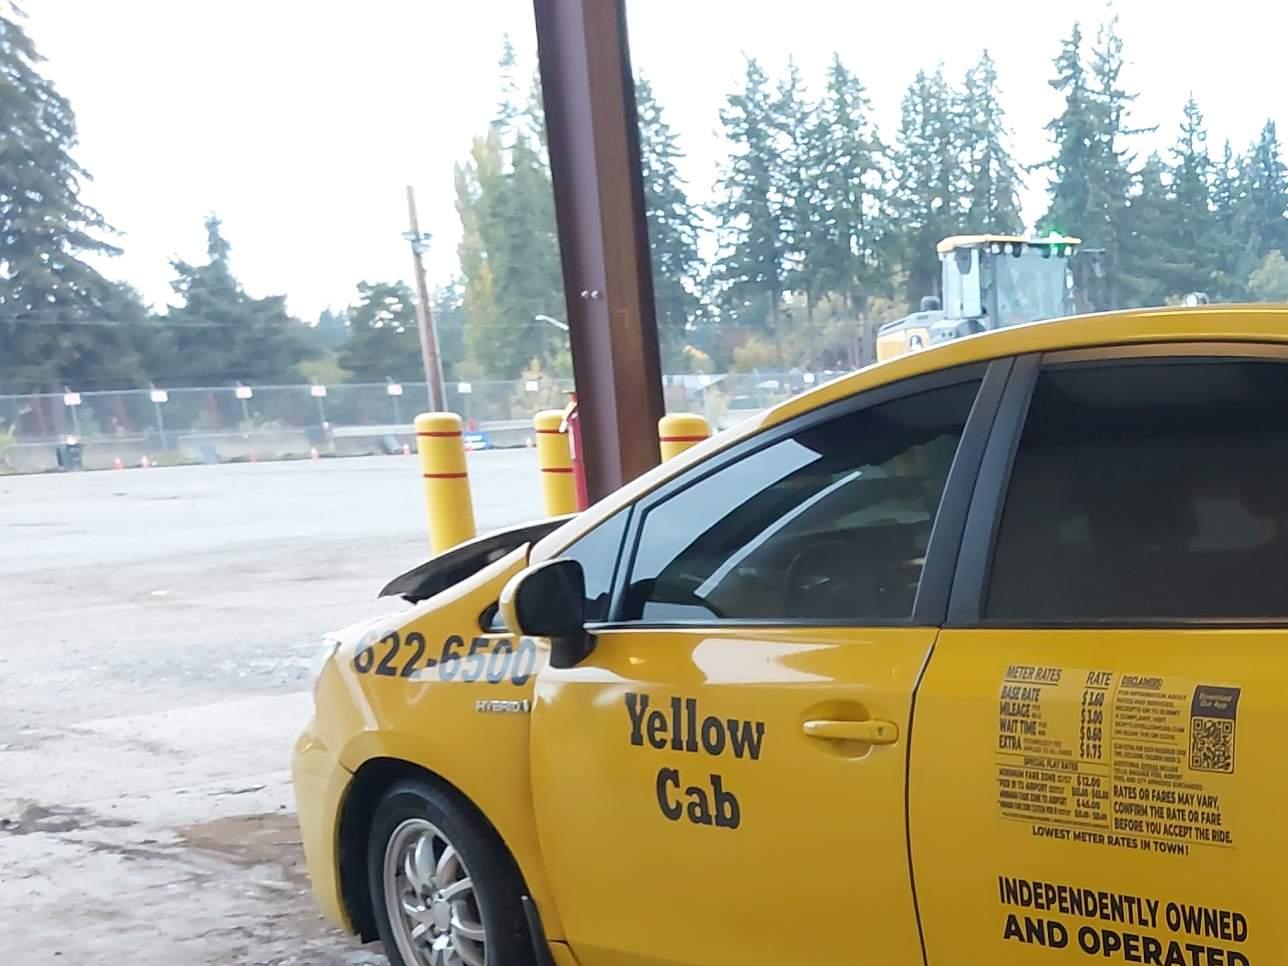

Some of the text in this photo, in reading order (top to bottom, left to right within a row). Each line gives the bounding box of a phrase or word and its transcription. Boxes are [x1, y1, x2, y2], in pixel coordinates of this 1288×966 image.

[354, 630, 537, 686] 622-6500
[1007, 665, 1062, 682] METER RATES
[1086, 671, 1112, 686] RATE
[475, 701, 520, 713] HYBRID
[625, 692, 765, 760] Yellow
[1000, 719, 1018, 734] WAIT
[1019, 720, 1037, 736] TIME
[999, 735, 1021, 750] EXTRA
[656, 767, 741, 830] Cab
[1113, 785, 1137, 799] RATES
[1138, 788, 1150, 801] OR
[1151, 789, 1176, 804] FARES
[1177, 792, 1196, 806] MAY
[1113, 802, 1148, 817] CONFIRM
[1149, 805, 1164, 819] THE
[1166, 807, 1187, 822] RATE
[1187, 810, 1200, 823] OR
[1201, 812, 1222, 826] FARE
[1032, 825, 1190, 856] LOWEST METER RATES IN TOWN!
[1114, 817, 1144, 832] BEFORE
[1145, 821, 1161, 835] YOU
[1163, 824, 1193, 839] ACCEPT
[1194, 827, 1210, 841] THE
[998, 876, 1248, 943] INDEPENDENTLY OWNED
[1003, 914, 1069, 949] AND
